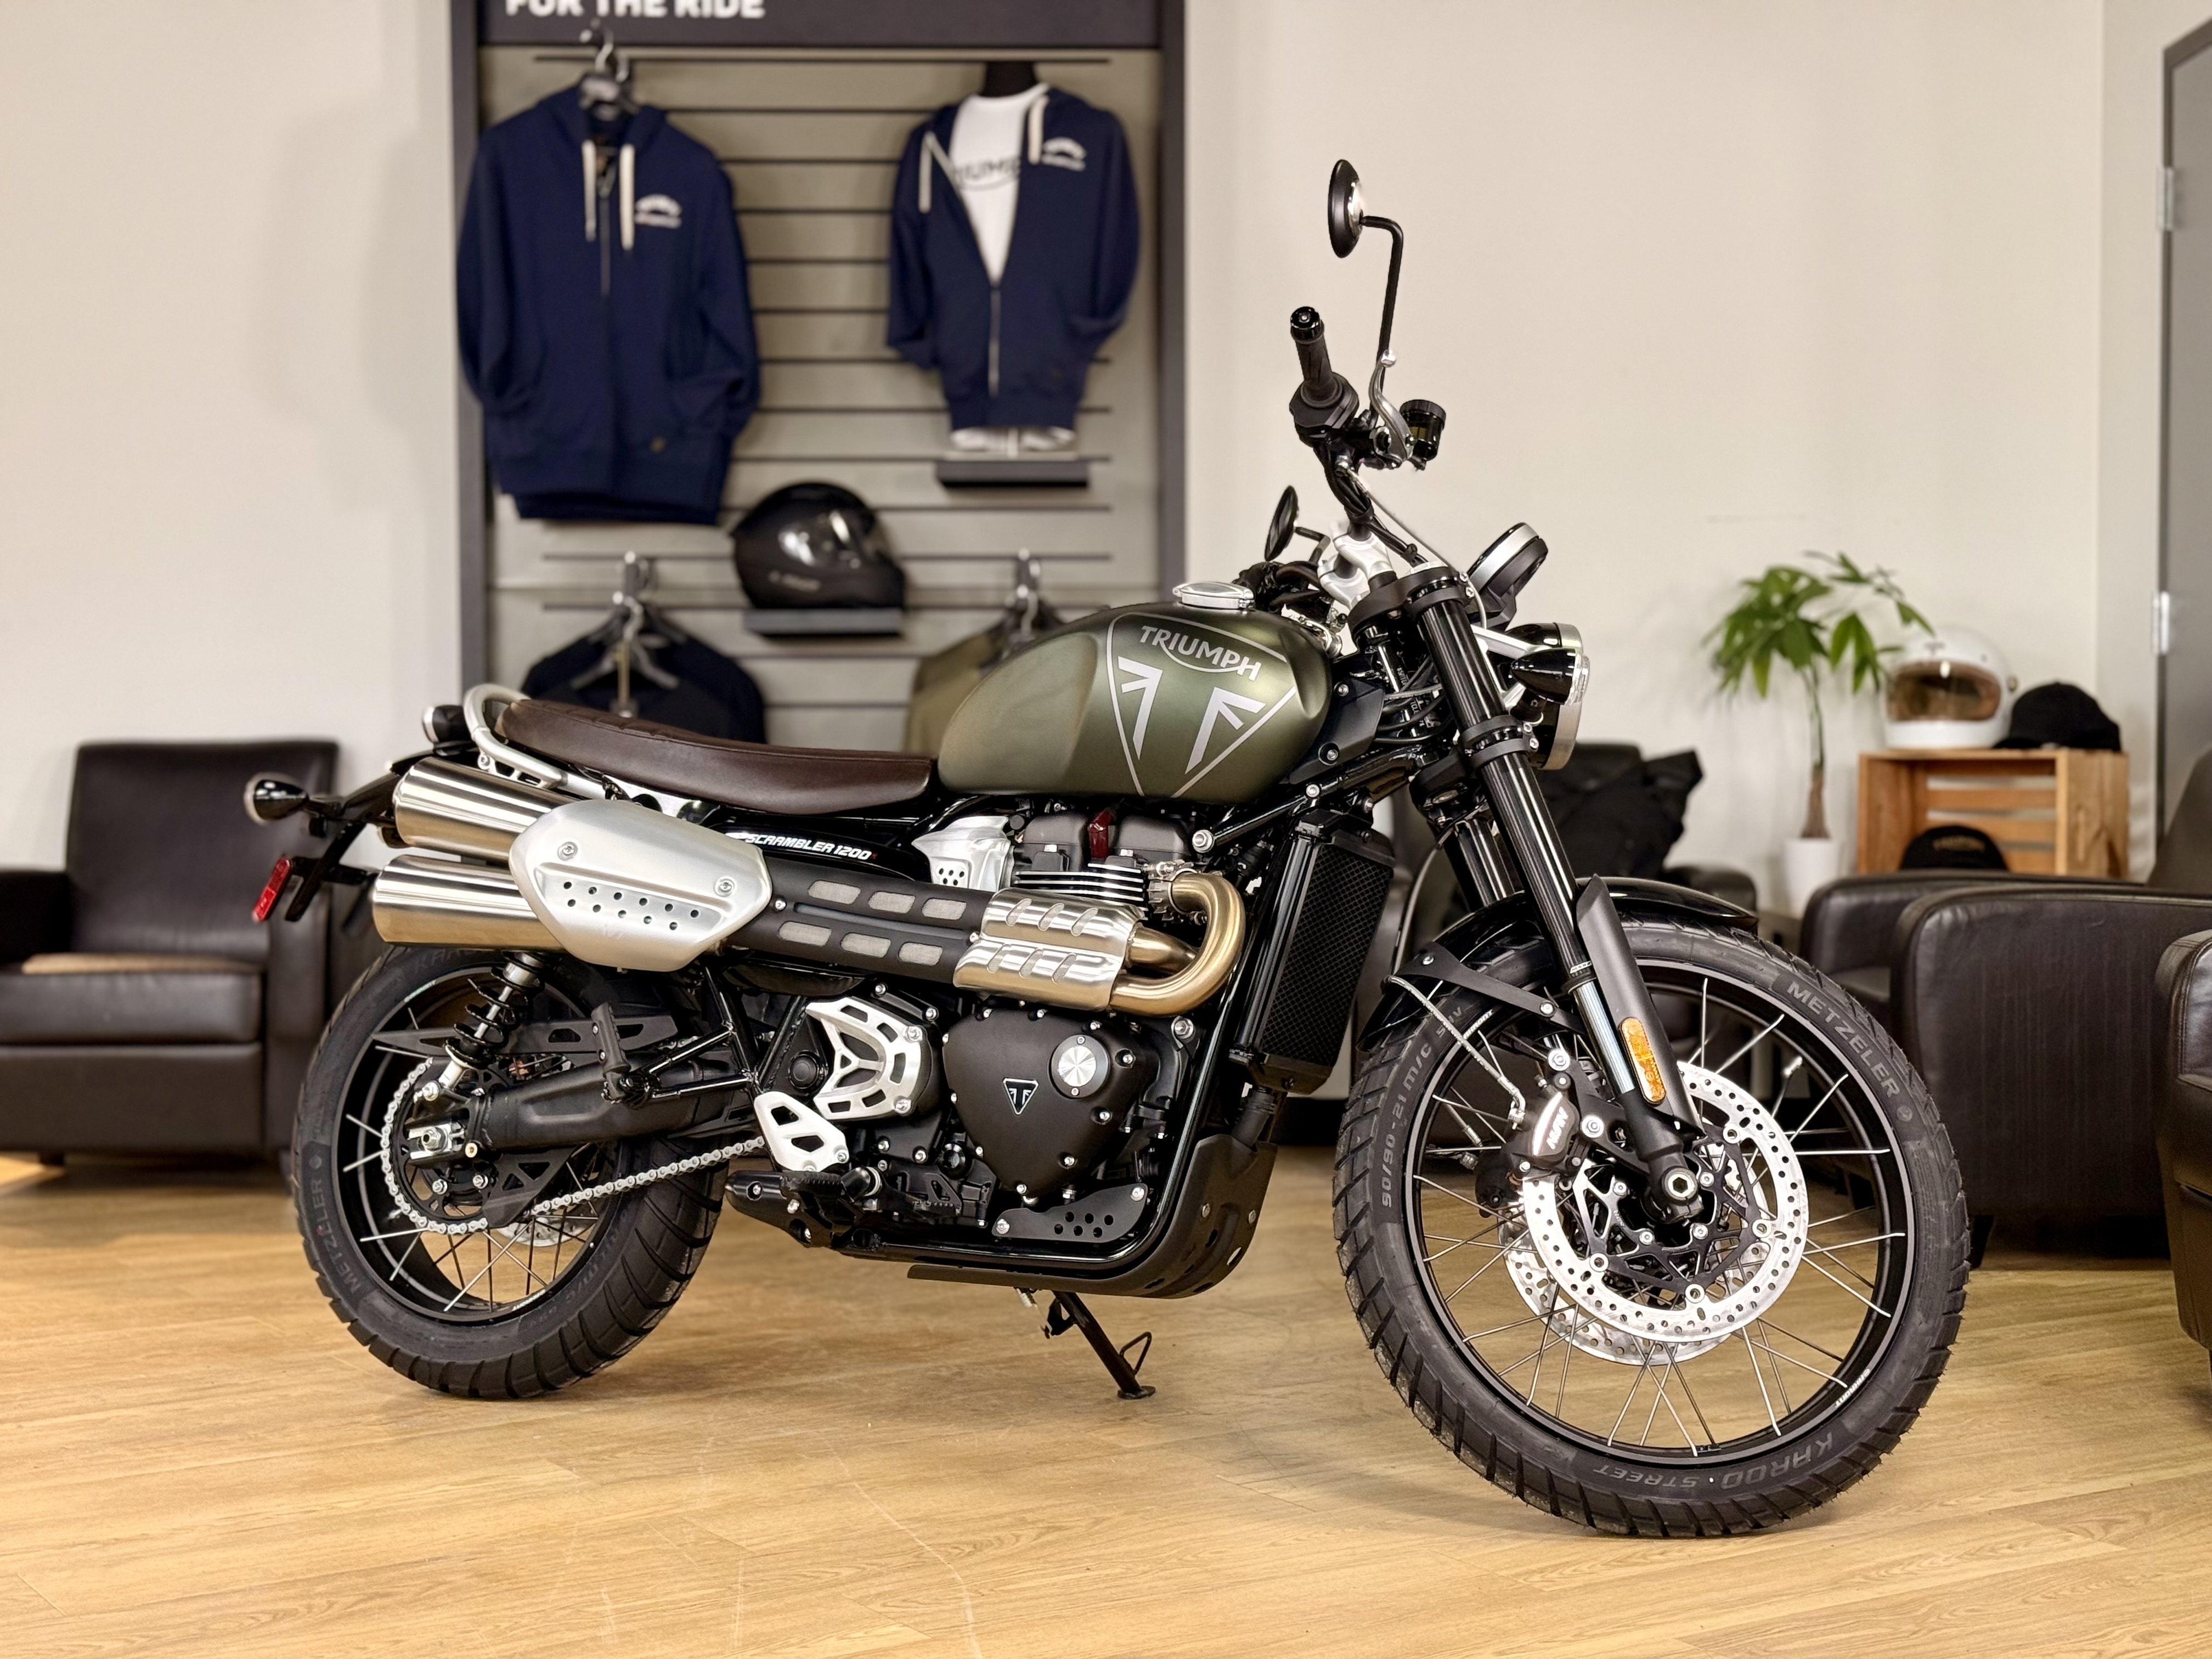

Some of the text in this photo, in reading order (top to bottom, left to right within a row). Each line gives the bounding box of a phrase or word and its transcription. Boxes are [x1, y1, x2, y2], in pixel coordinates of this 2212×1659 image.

[1140, 625, 1261, 681] TRIUMPH
[746, 833, 834, 853] SCRAMBLER
[834, 845, 872, 860] 1200
[1786, 981, 1900, 1098] METZELER
[1402, 1043, 1433, 1091] M/C
[311, 1178, 362, 1294] METZELER
[1593, 1464, 1700, 1488] STREET
